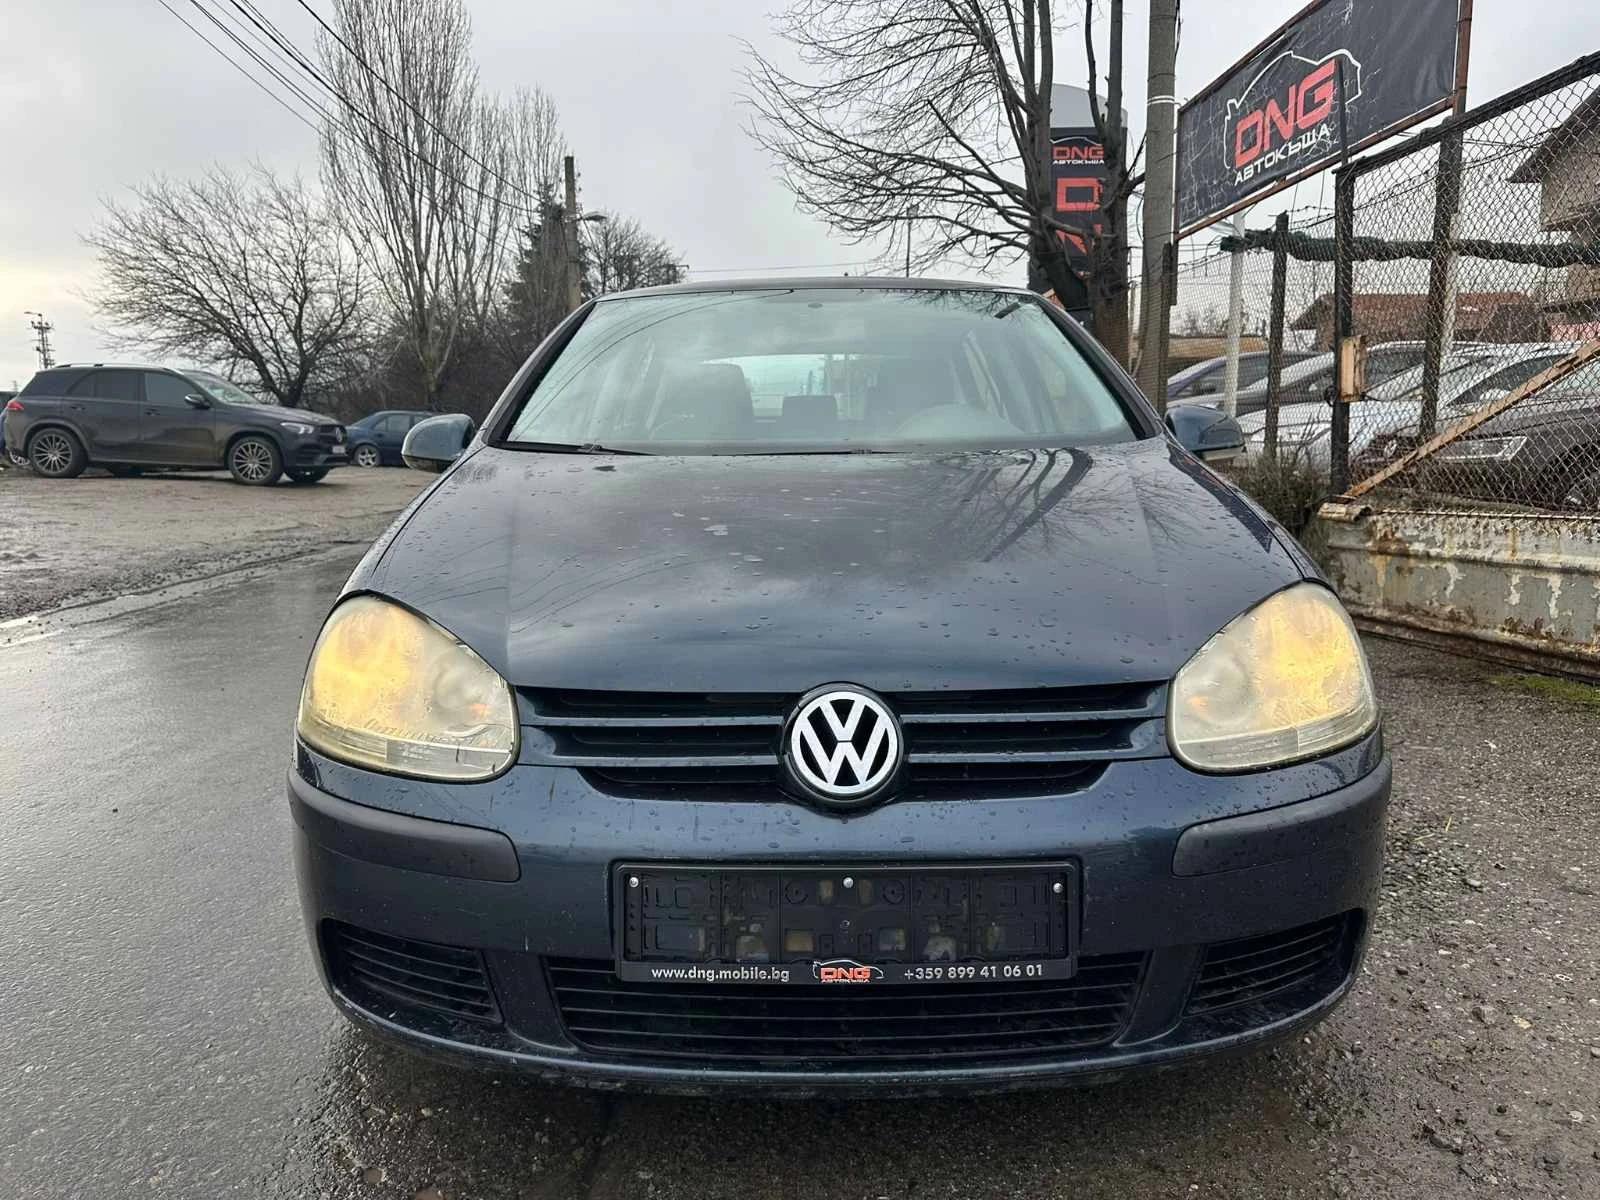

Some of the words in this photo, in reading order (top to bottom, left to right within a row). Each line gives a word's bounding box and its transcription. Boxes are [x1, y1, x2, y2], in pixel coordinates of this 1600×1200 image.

[1235, 59, 1336, 169] DNG
[1053, 146, 1105, 160] DNG
[651, 966, 790, 982] www.dng.mobile.bg
[820, 967, 871, 979] DNG
[904, 967, 943, 980] +359
[947, 966, 976, 979] 899
[980, 965, 997, 979] 41
[1003, 965, 1021, 977] 06
[1025, 964, 1043, 976] 01
